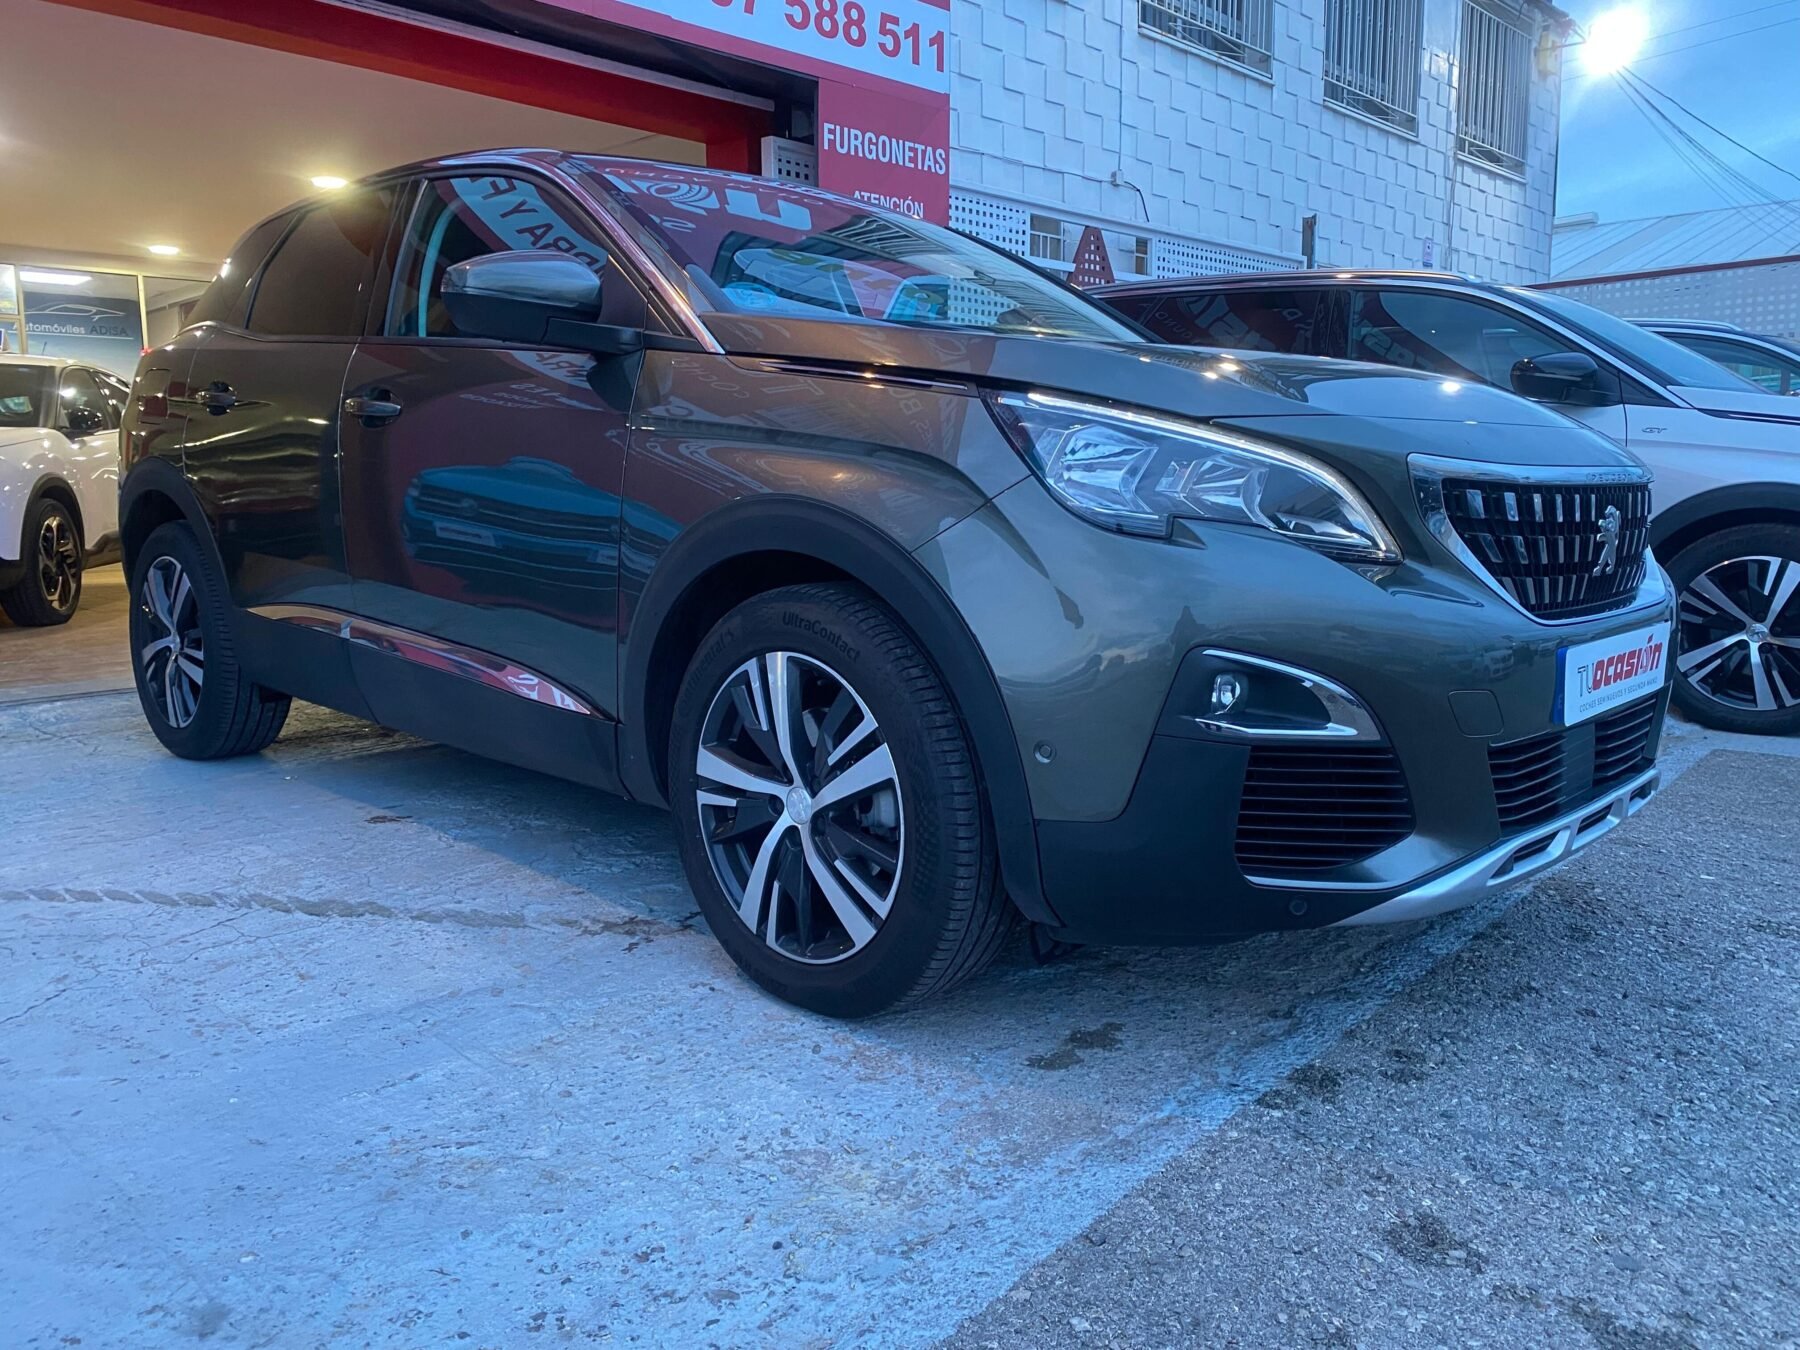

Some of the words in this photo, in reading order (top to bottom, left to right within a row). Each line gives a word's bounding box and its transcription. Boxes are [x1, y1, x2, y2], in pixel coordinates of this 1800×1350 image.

[784, 0, 867, 48] 588
[877, 11, 945, 73] 511
[823, 121, 946, 175] FURGONETAS
[89, 324, 129, 337] ADISA
[782, 610, 861, 662] UltraContact
